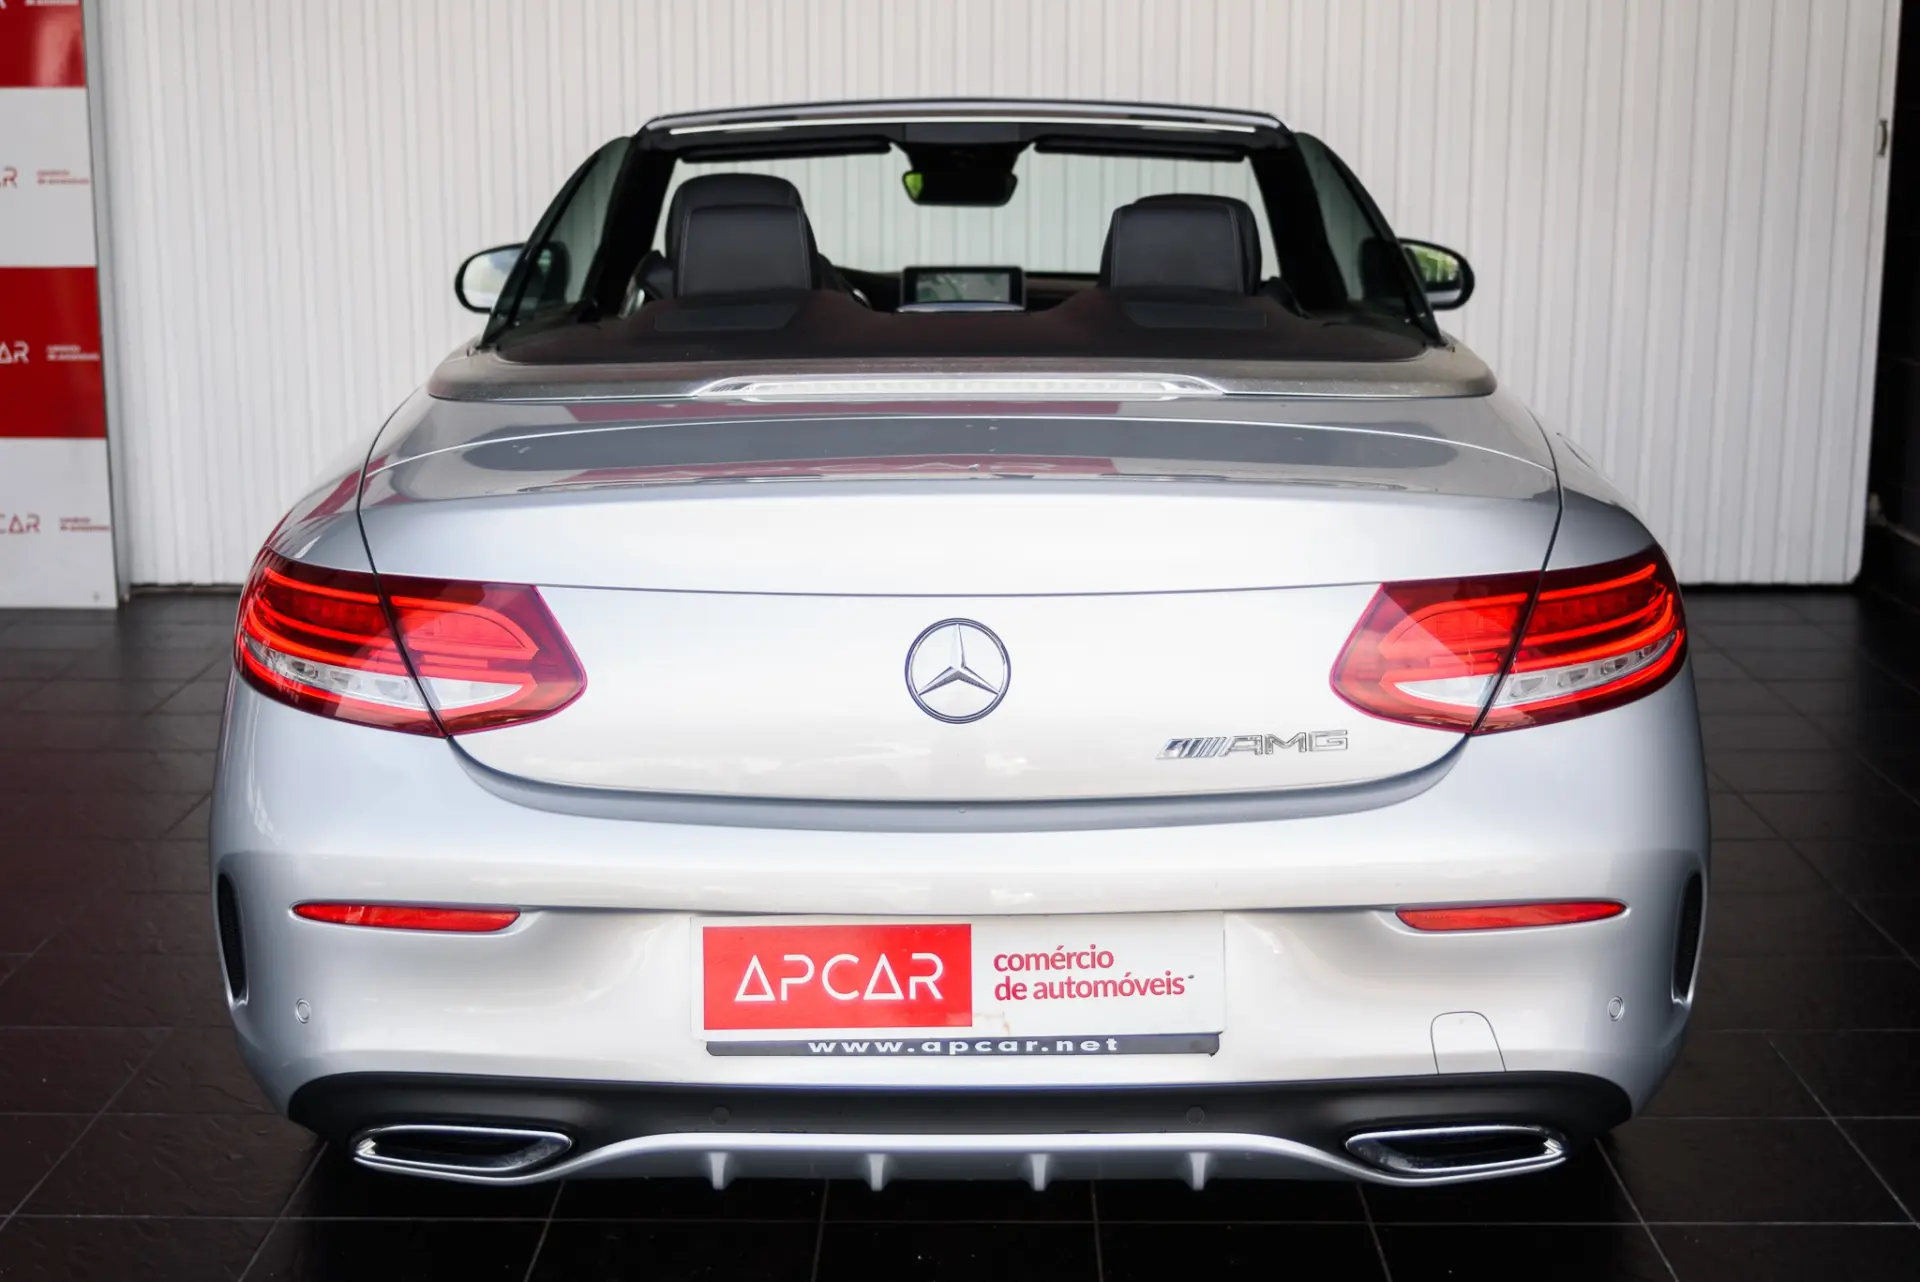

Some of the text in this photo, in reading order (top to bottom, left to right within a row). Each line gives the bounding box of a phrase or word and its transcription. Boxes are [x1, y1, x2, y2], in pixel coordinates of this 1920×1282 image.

[1219, 730, 1348, 757] AMG
[993, 944, 1114, 972] comércio
[735, 952, 944, 1002] APCAR
[994, 970, 1185, 1001] de automóveis
[808, 1038, 1118, 1055] www.apcar.net
